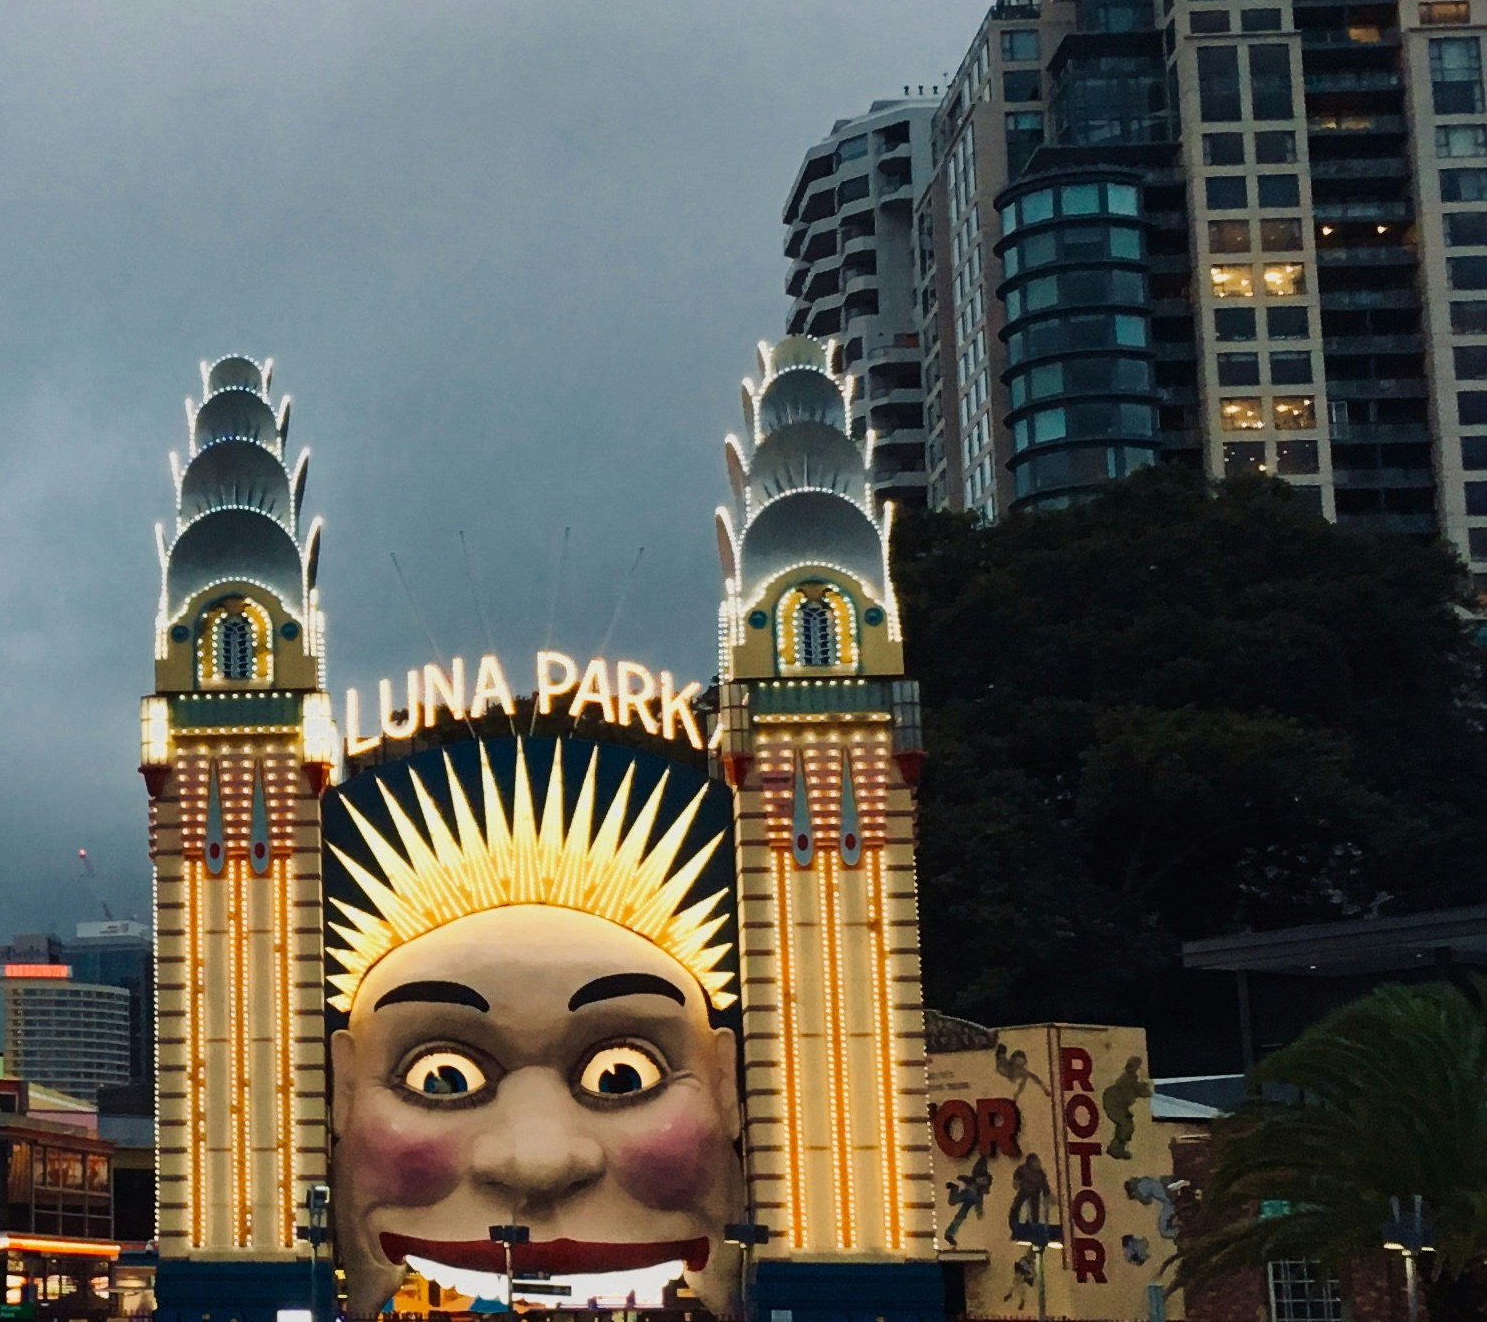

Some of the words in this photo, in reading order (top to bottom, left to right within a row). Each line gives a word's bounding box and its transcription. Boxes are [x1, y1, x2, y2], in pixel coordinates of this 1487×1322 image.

[346, 654, 516, 756] LUNA
[536, 651, 704, 750] PARK
[931, 1098, 1022, 1159] OR
[1061, 1047, 1108, 1284] ROTOR
